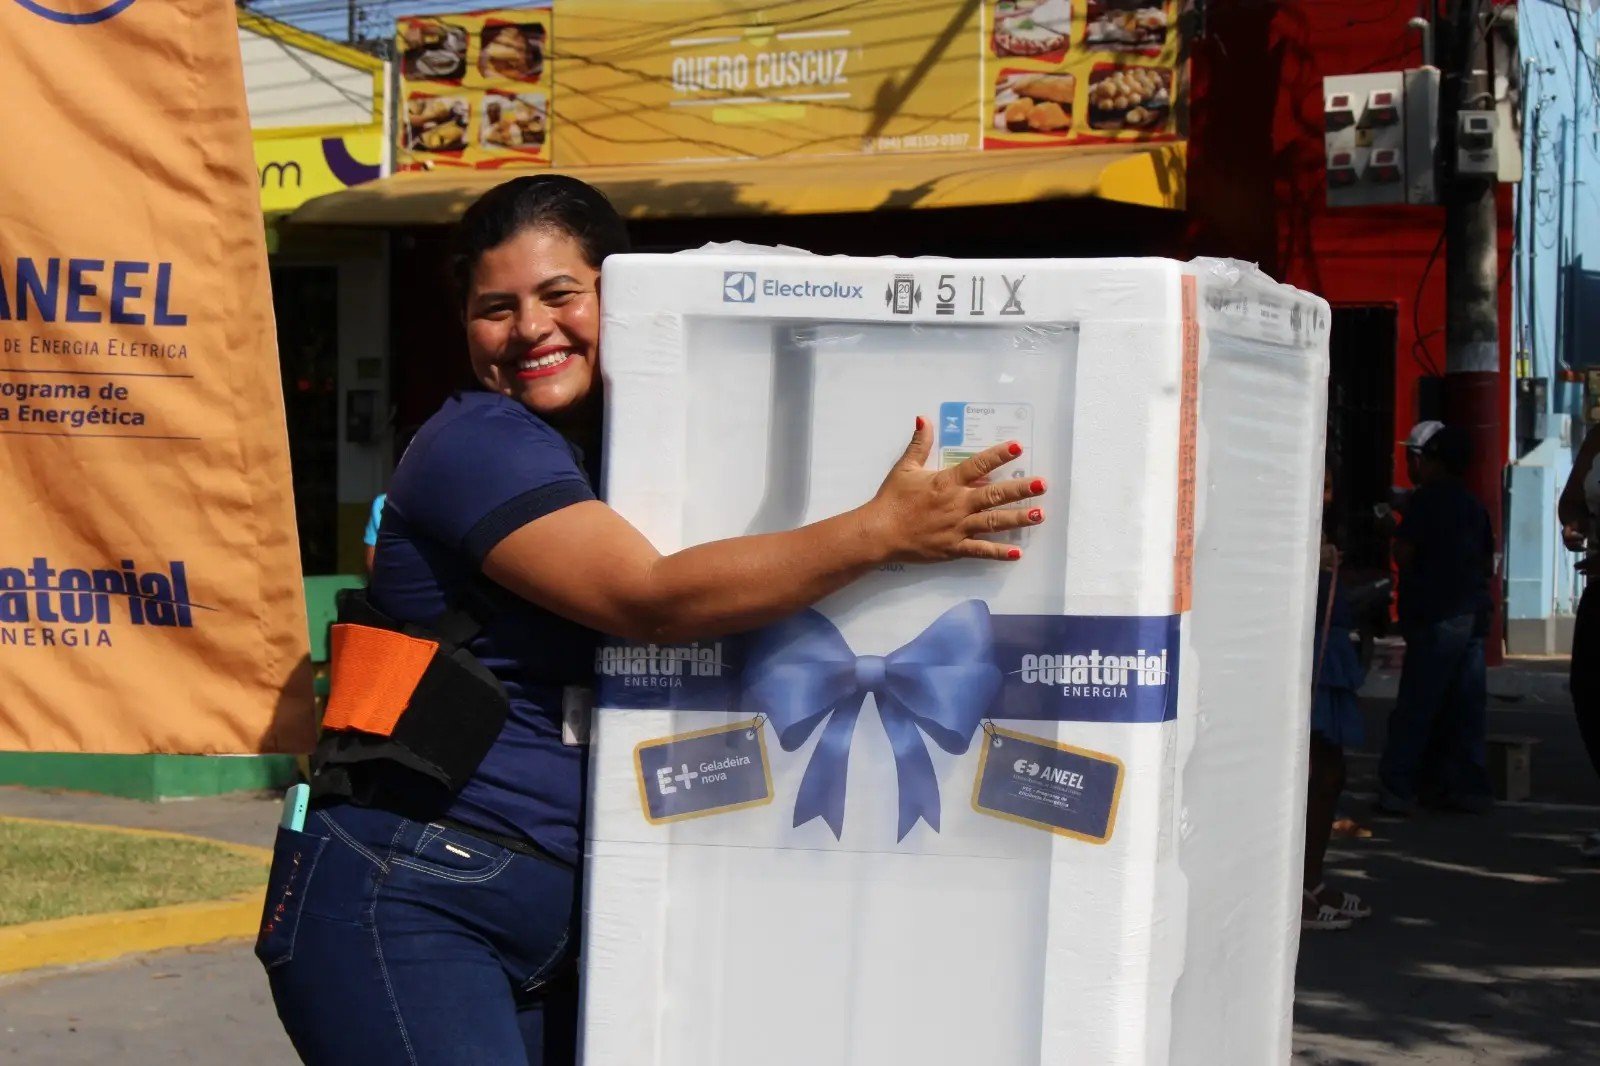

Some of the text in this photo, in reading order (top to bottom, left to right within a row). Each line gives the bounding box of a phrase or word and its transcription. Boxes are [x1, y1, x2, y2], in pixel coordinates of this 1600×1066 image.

[672, 49, 848, 94] QUERO CUSCUZ
[0, 257, 188, 326] NEEL
[763, 279, 863, 299] Electrolux
[898, 284, 910, 293] 20
[937, 274, 956, 303] 5
[4, 338, 21, 353] DE
[30, 336, 100, 356] ENERGIA
[0, 382, 129, 400] ograma de
[18, 405, 145, 427] Energética
[1021, 649, 1167, 686] equatorial
[624, 676, 683, 688] ENERGIA
[1063, 686, 1128, 698] ENERGIA
[699, 755, 751, 773] Geladeira
[701, 771, 728, 785] nova
[1040, 766, 1084, 790] ANEEL
